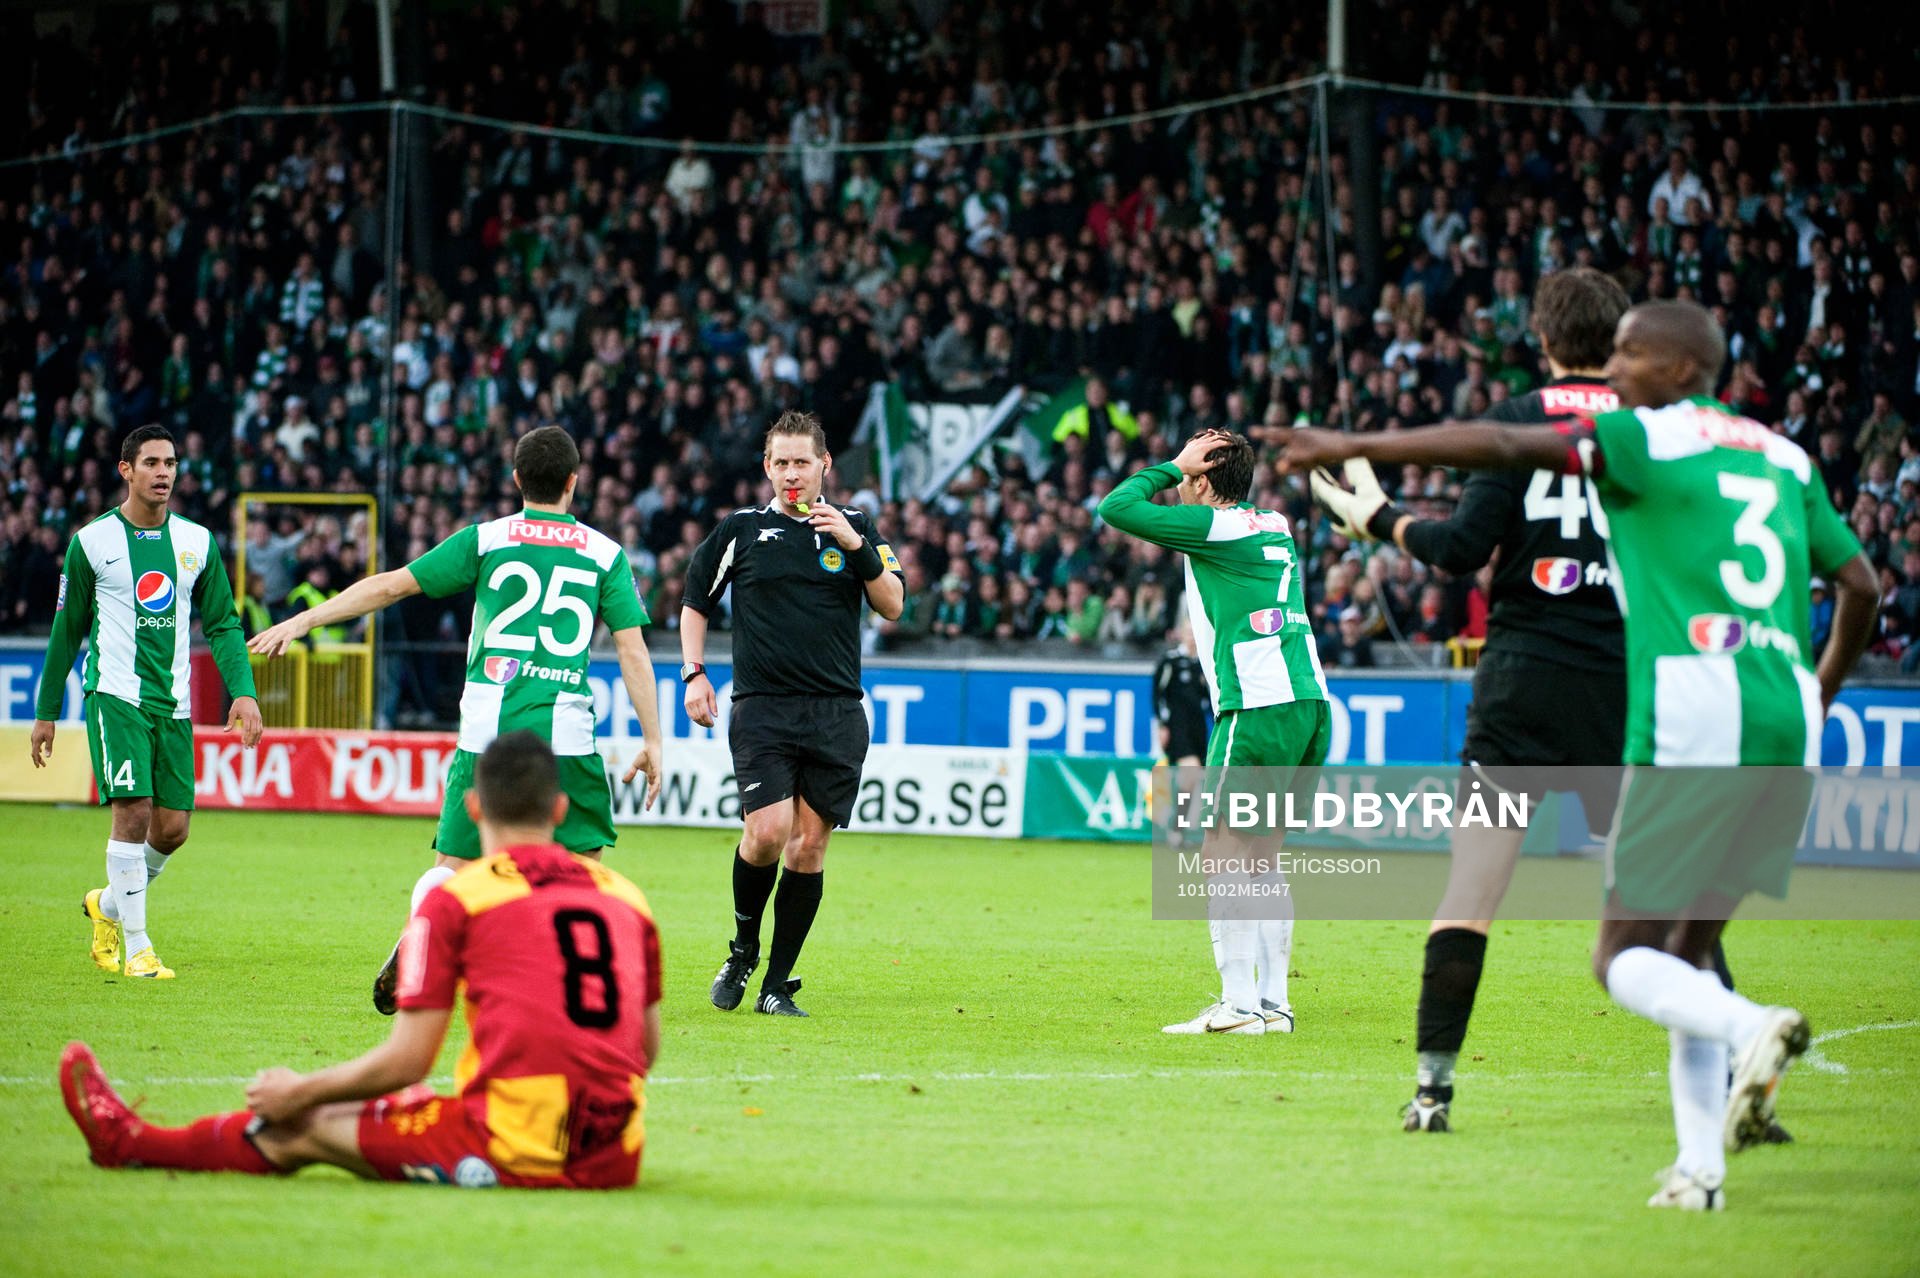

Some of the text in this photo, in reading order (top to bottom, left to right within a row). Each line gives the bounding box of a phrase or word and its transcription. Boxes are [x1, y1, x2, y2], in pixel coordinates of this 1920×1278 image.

[510, 521, 587, 545] FOLKIA
[1717, 471, 1786, 609] 3
[484, 560, 598, 657] 25
[1262, 546, 1296, 603] 7
[136, 615, 176, 630] pepsi
[554, 907, 620, 1030] 8
